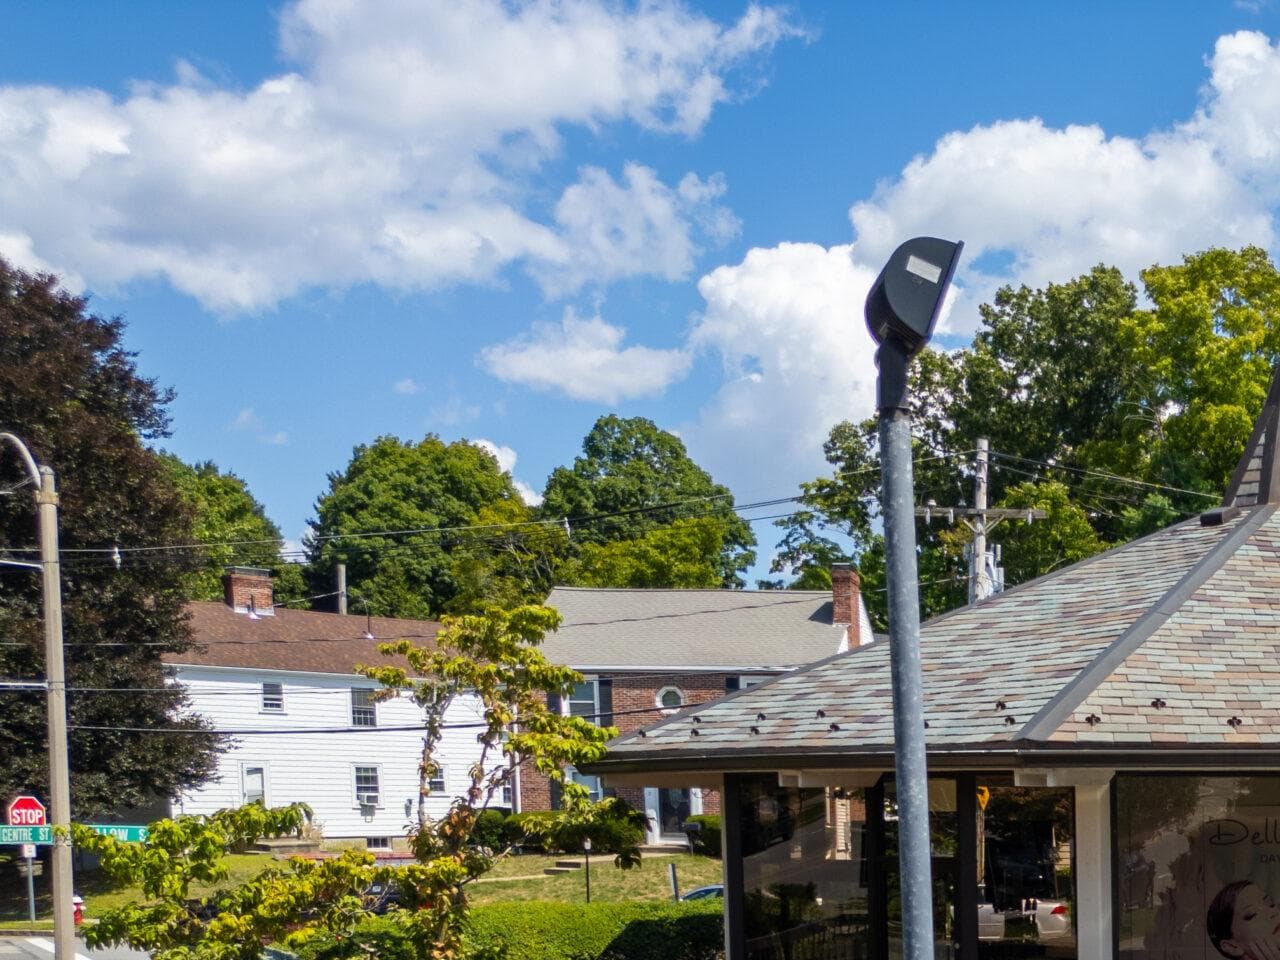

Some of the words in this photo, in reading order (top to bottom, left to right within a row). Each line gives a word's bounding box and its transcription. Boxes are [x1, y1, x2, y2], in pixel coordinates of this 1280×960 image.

[12, 809, 43, 824] STOP
[2, 828, 33, 841] CENTRE
[39, 828, 50, 841] ST
